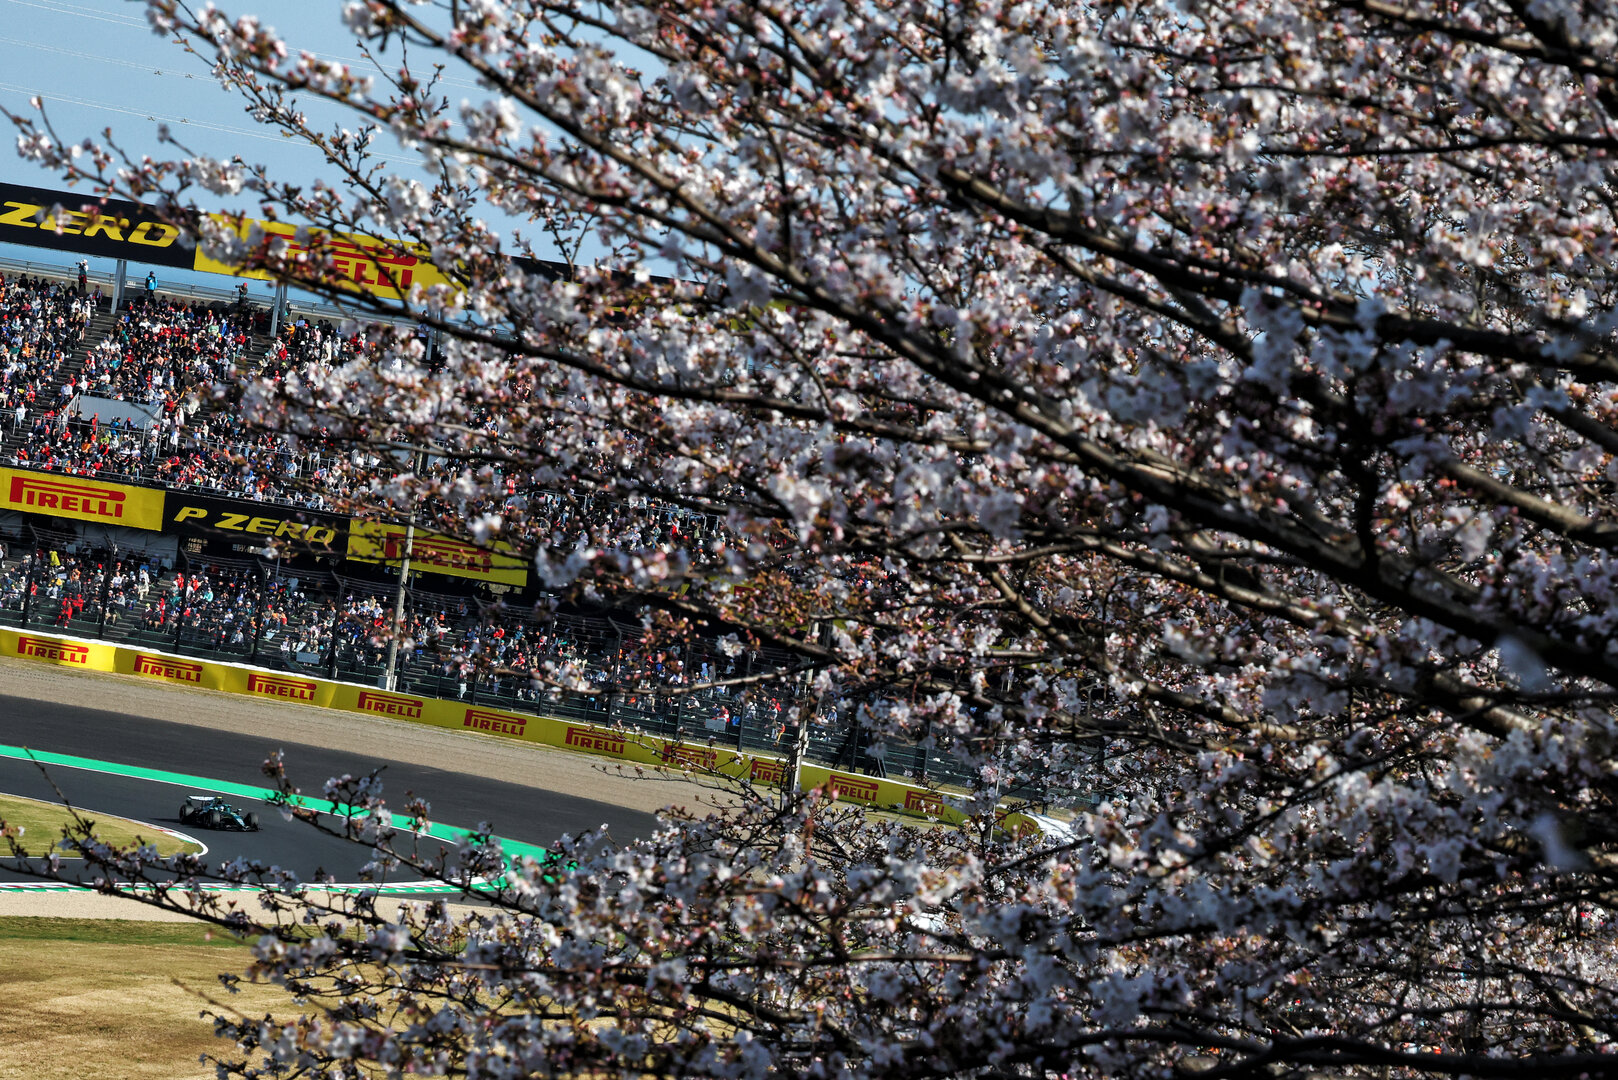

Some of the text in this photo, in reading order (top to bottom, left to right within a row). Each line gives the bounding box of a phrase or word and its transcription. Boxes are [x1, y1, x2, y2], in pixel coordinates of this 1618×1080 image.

[0, 201, 180, 247] ZERO
[9, 476, 126, 518] PIRELLI
[174, 506, 335, 543] P ZERO
[17, 637, 89, 664] PIRELLI
[134, 655, 203, 682] PIRELLI
[247, 674, 317, 701] PIRELLI
[357, 691, 424, 718] PIRELLI
[463, 709, 527, 736] PIRELLI
[565, 727, 626, 754] PIRELLI
[829, 775, 879, 801] PIRELLI
